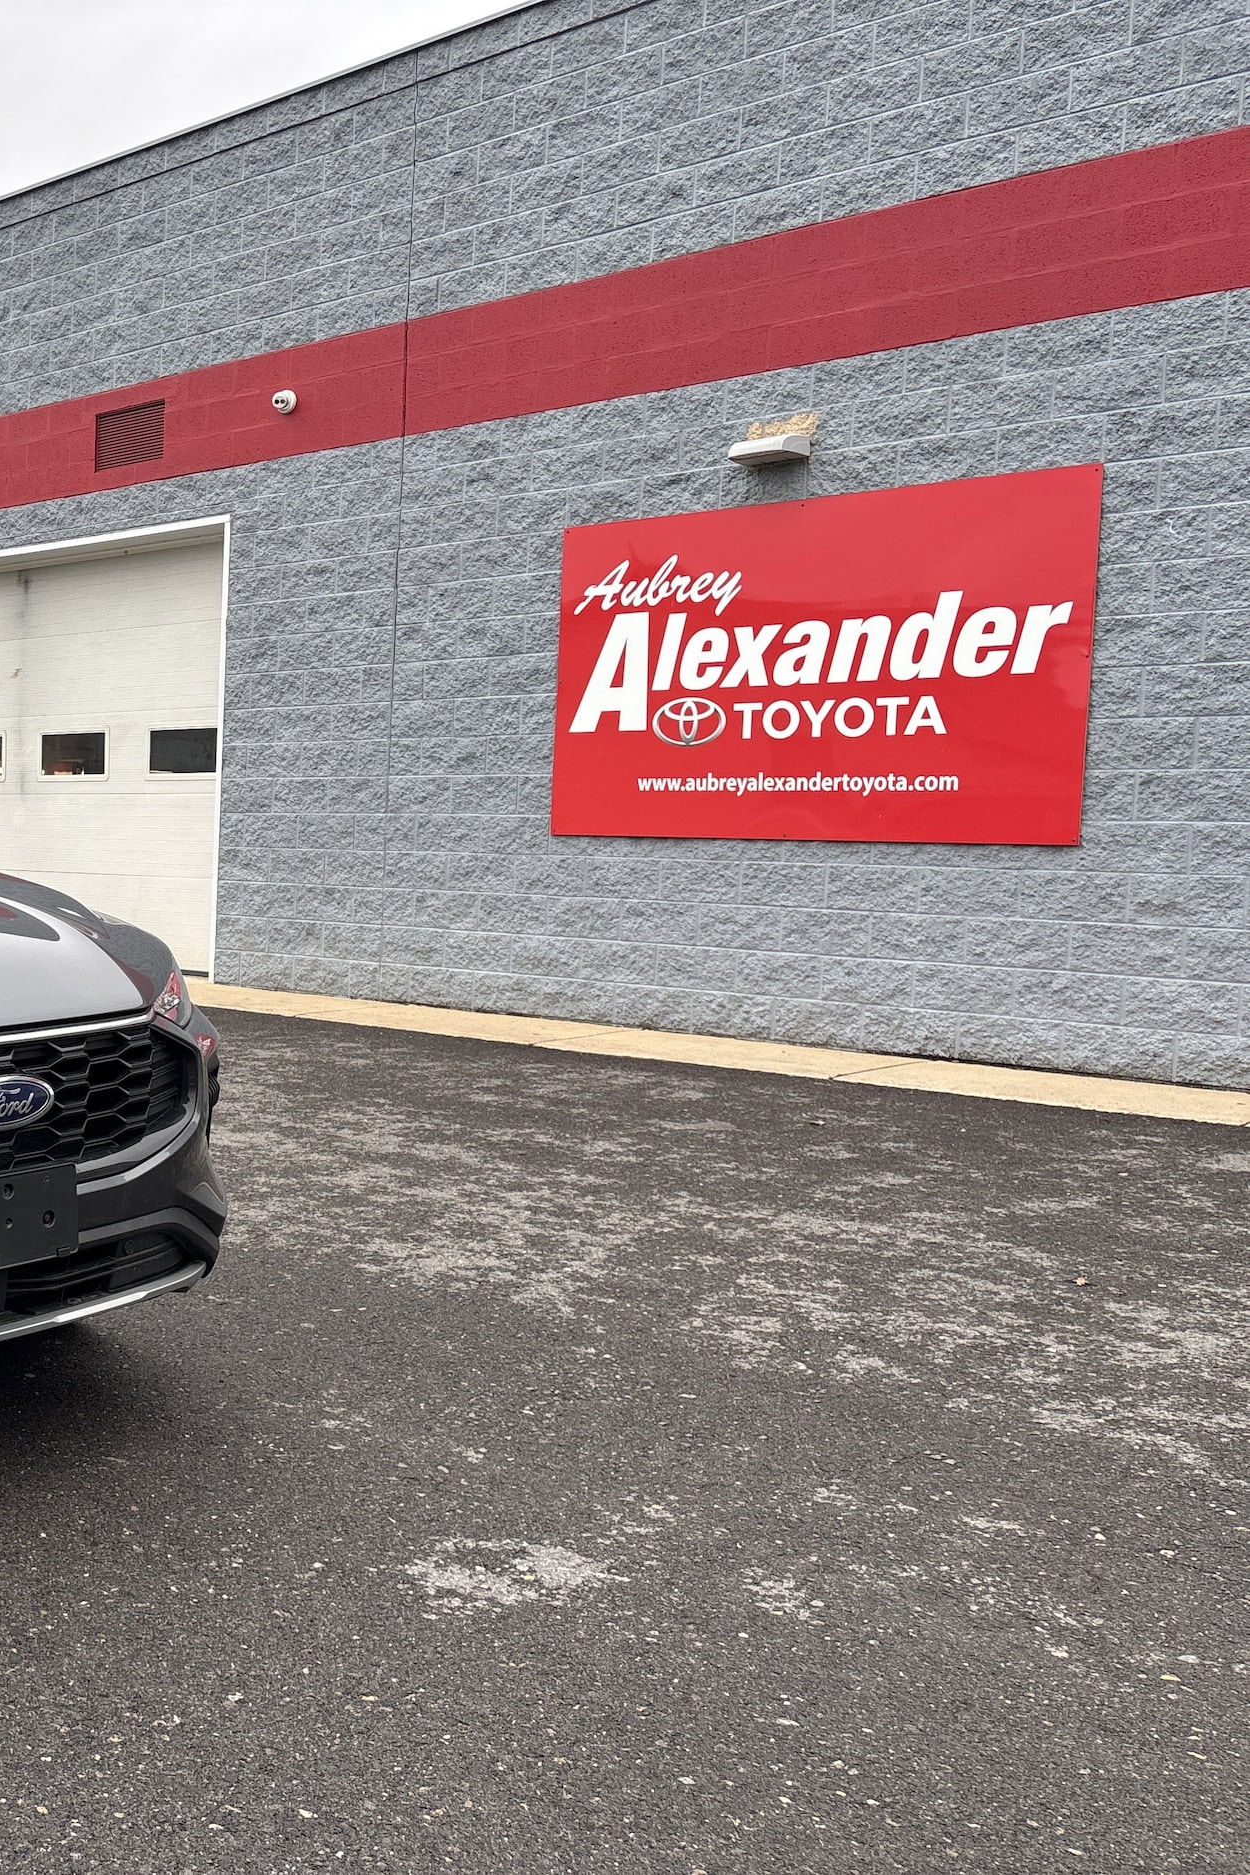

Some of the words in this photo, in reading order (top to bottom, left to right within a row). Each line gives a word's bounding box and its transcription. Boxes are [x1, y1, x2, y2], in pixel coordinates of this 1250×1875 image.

[573, 554, 742, 617] Aubrey
[568, 590, 1074, 733] Alexander
[733, 695, 947, 740] TOYOTA
[637, 770, 959, 797] www.aubreyalexandertoyota.com
